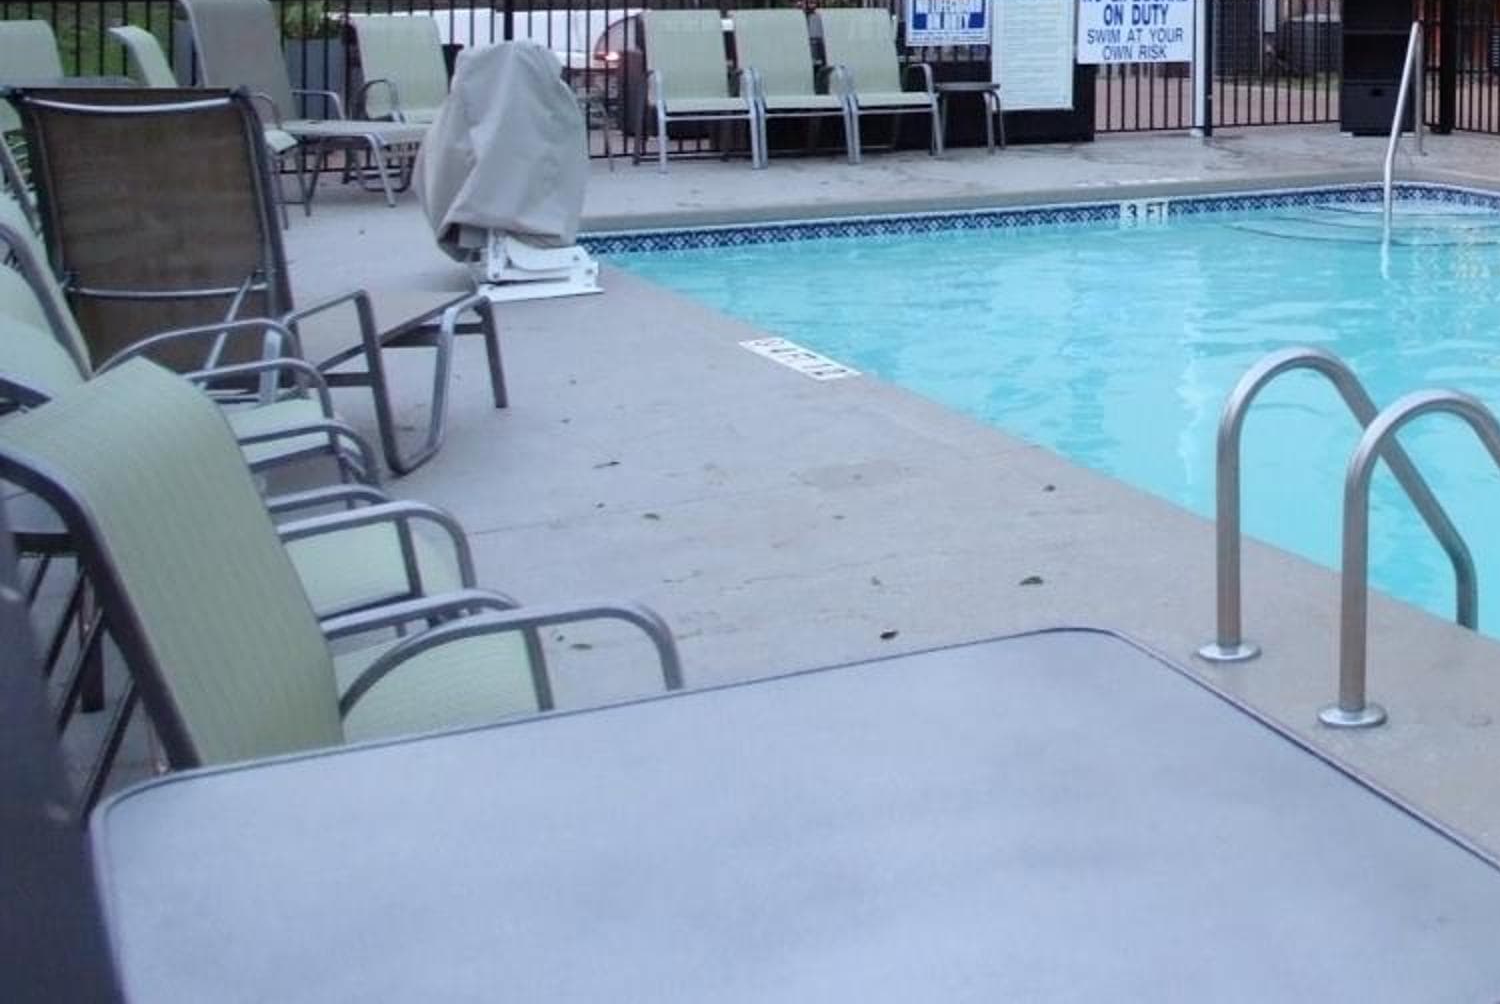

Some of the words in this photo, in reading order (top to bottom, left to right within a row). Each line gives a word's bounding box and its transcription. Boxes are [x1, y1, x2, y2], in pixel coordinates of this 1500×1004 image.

[1103, 4, 1123, 26] ON
[1132, 4, 1169, 25] DUTY
[1087, 28, 1120, 44] SWIM
[1127, 28, 1143, 42] AT
[1150, 27, 1184, 43] YOUR
[1103, 45, 1132, 60] OWN
[1138, 45, 1167, 59] RISK
